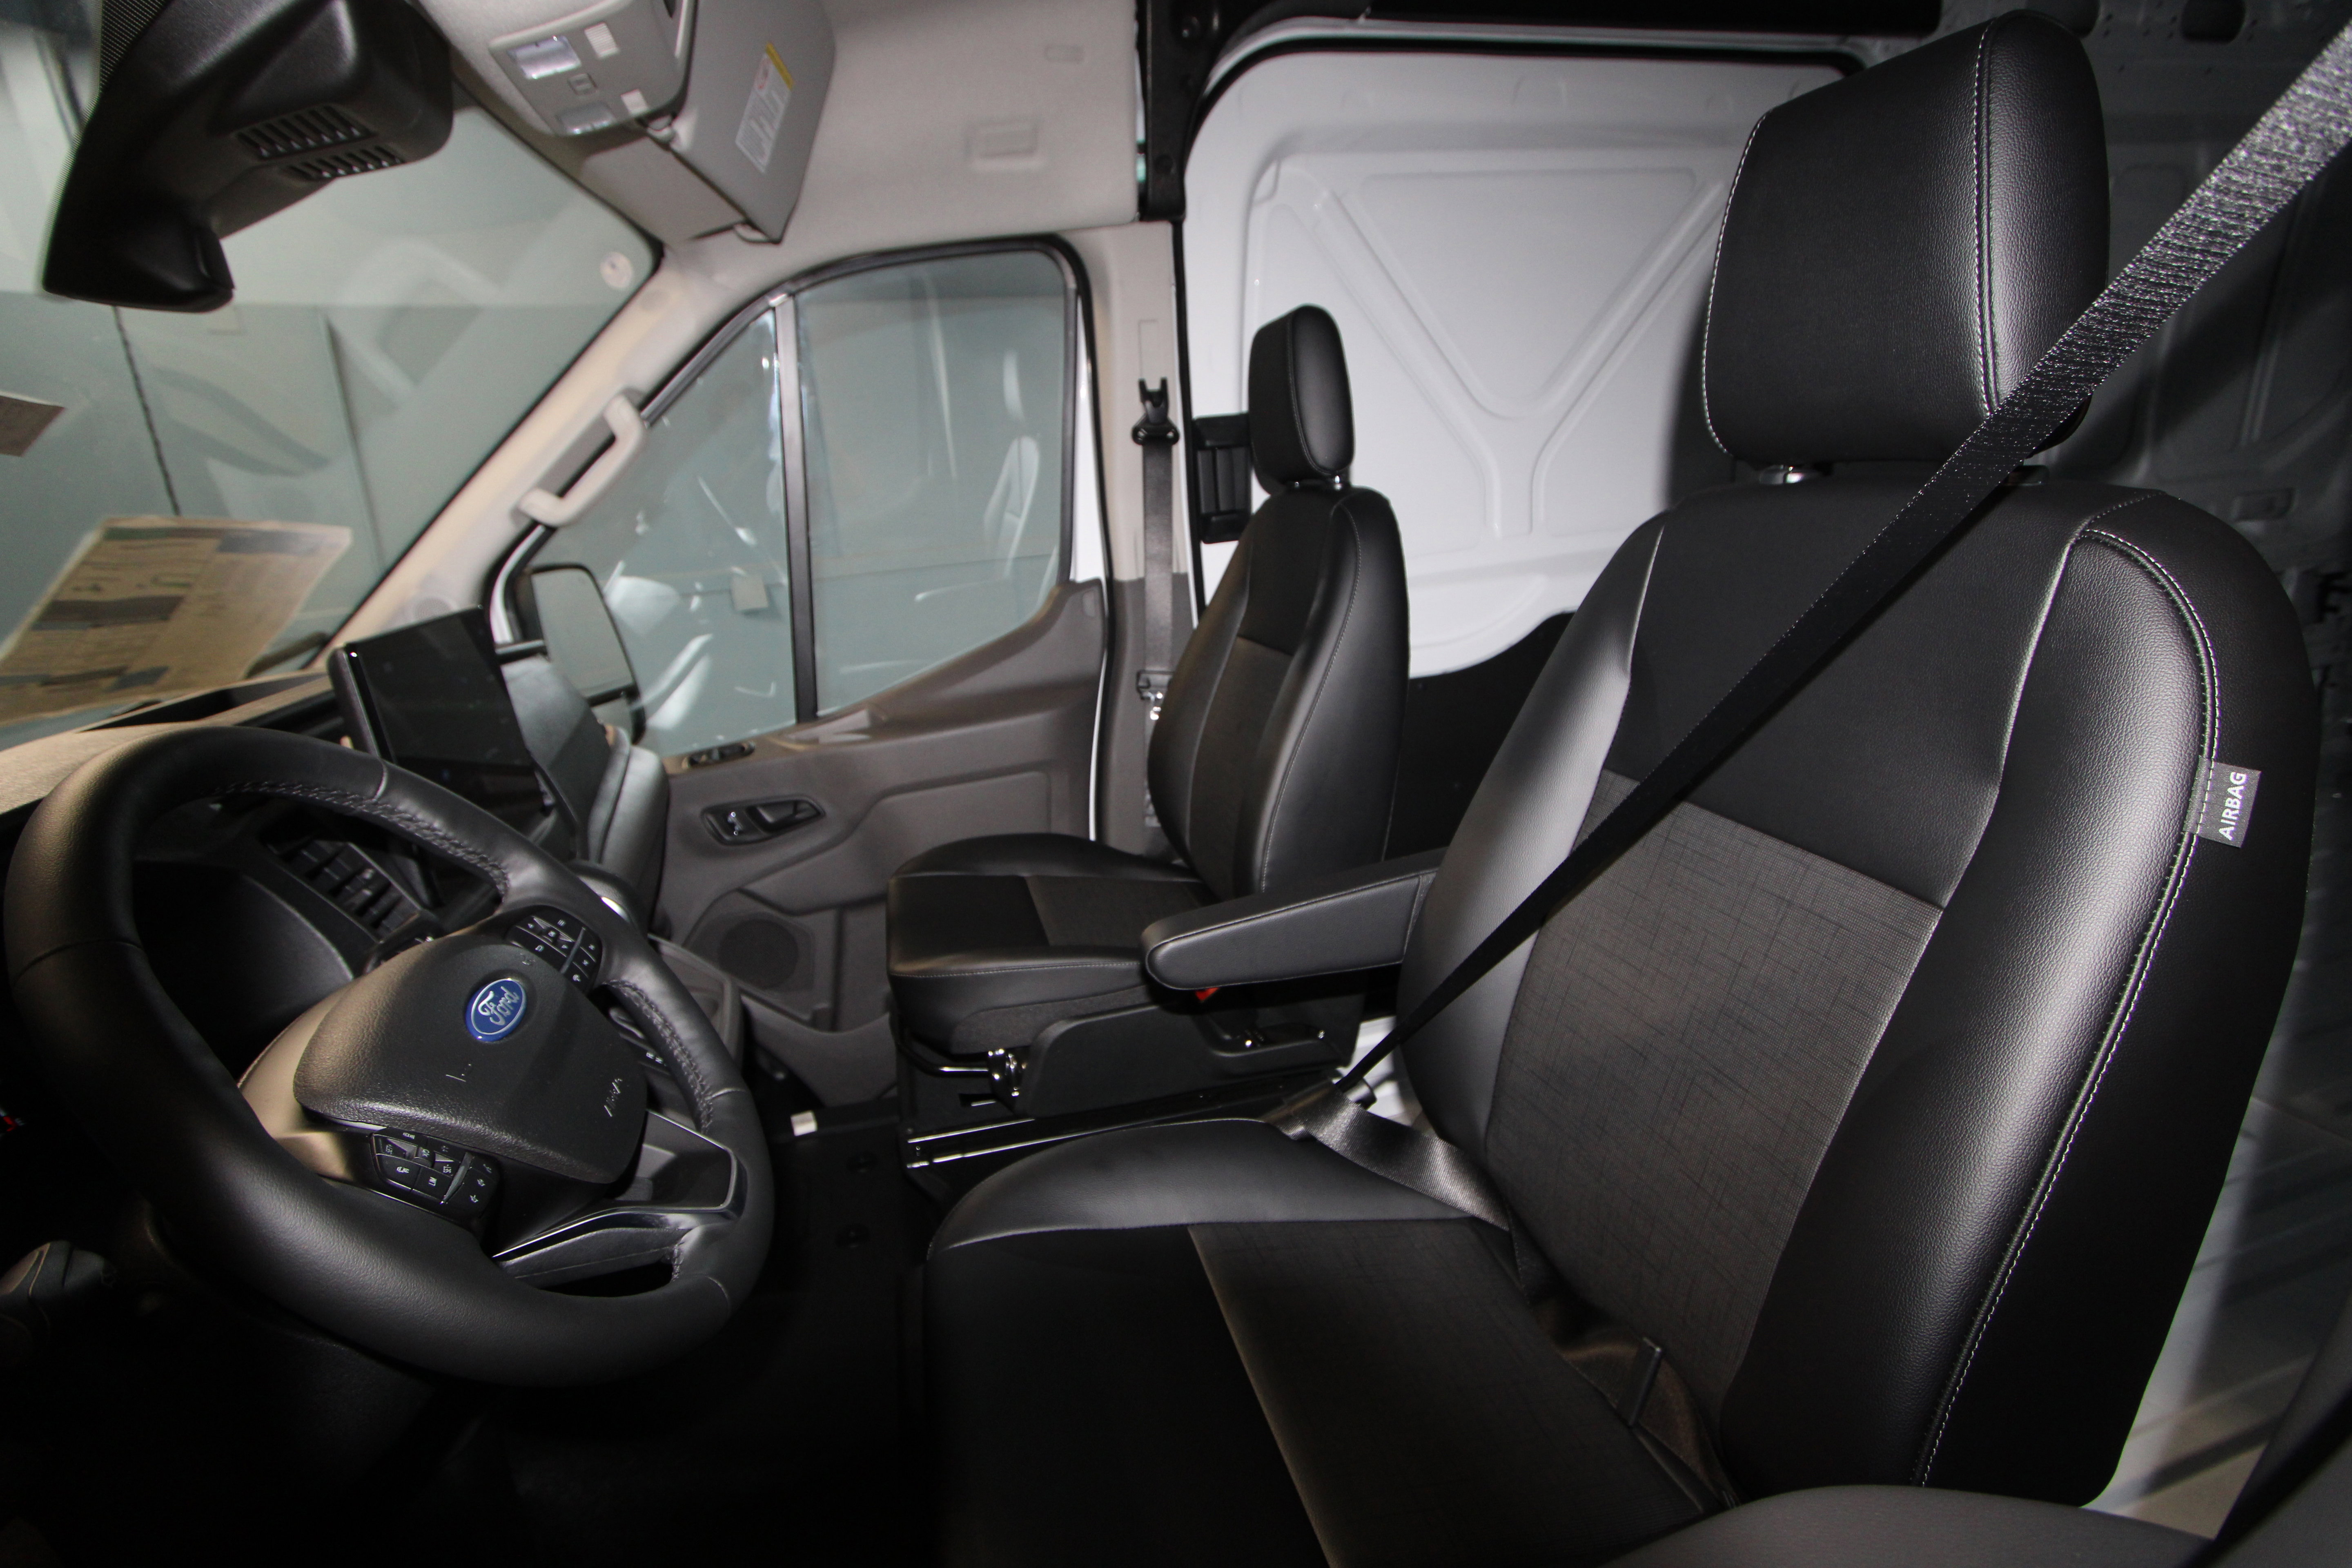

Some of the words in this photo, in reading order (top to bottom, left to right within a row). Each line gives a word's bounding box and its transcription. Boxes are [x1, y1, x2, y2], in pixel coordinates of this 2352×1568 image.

[2218, 771, 2248, 841] AIRBAG
[478, 986, 519, 1026] Ford
[428, 1176, 437, 1186] LIM
